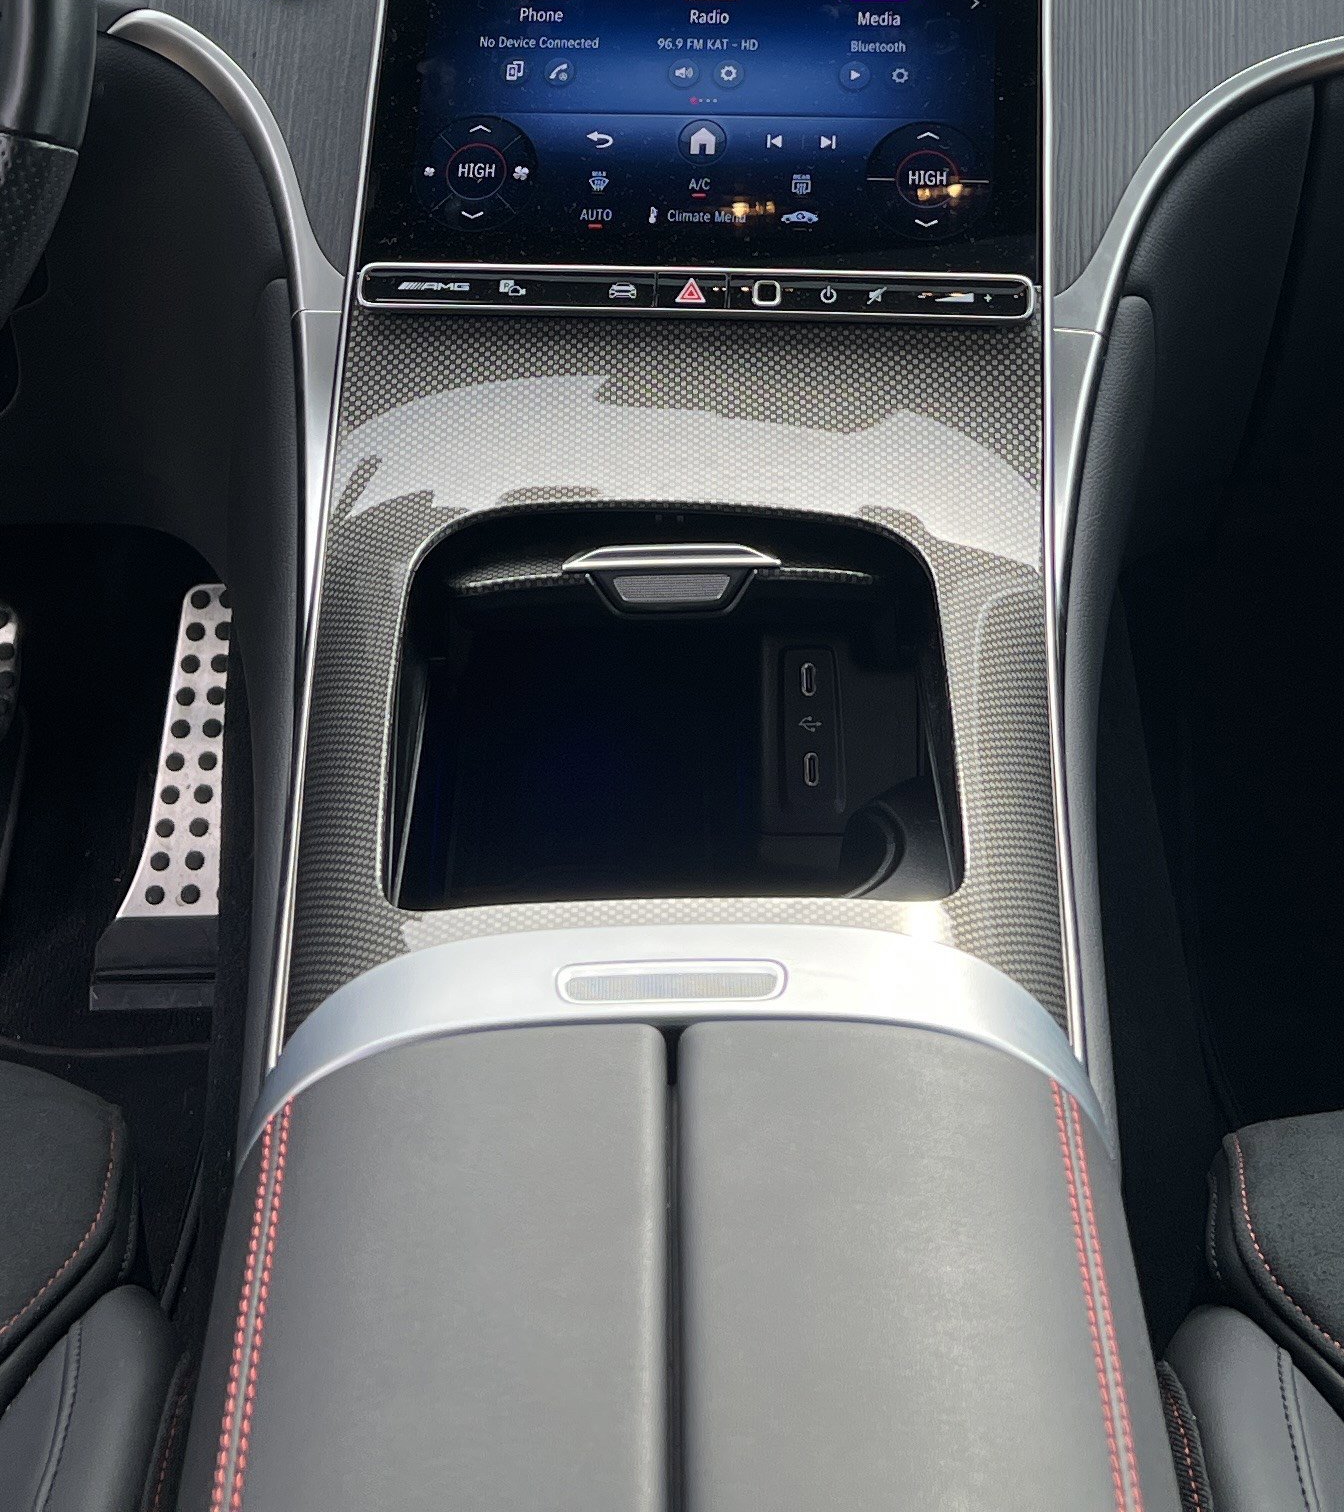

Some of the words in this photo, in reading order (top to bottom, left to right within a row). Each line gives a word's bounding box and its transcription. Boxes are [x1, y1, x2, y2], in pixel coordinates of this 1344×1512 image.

[519, 6, 564, 23] Phone
[689, 8, 730, 25] Radio
[857, 11, 901, 28] Media
[479, 36, 493, 49] No
[496, 36, 536, 50] Device
[539, 36, 600, 50] Connected
[657, 37, 684, 51] 96.9
[687, 38, 704, 51] FM
[707, 38, 729, 51] KAT
[741, 38, 758, 51] HD
[850, 40, 906, 54] Bluetooth
[458, 162, 495, 180] HIGH
[907, 168, 948, 187] HIGH
[688, 178, 711, 191] A/C
[580, 208, 612, 221] AUTO
[667, 209, 711, 223] Climate
[714, 211, 747, 224] Menu
[420, 281, 470, 291] AMG
